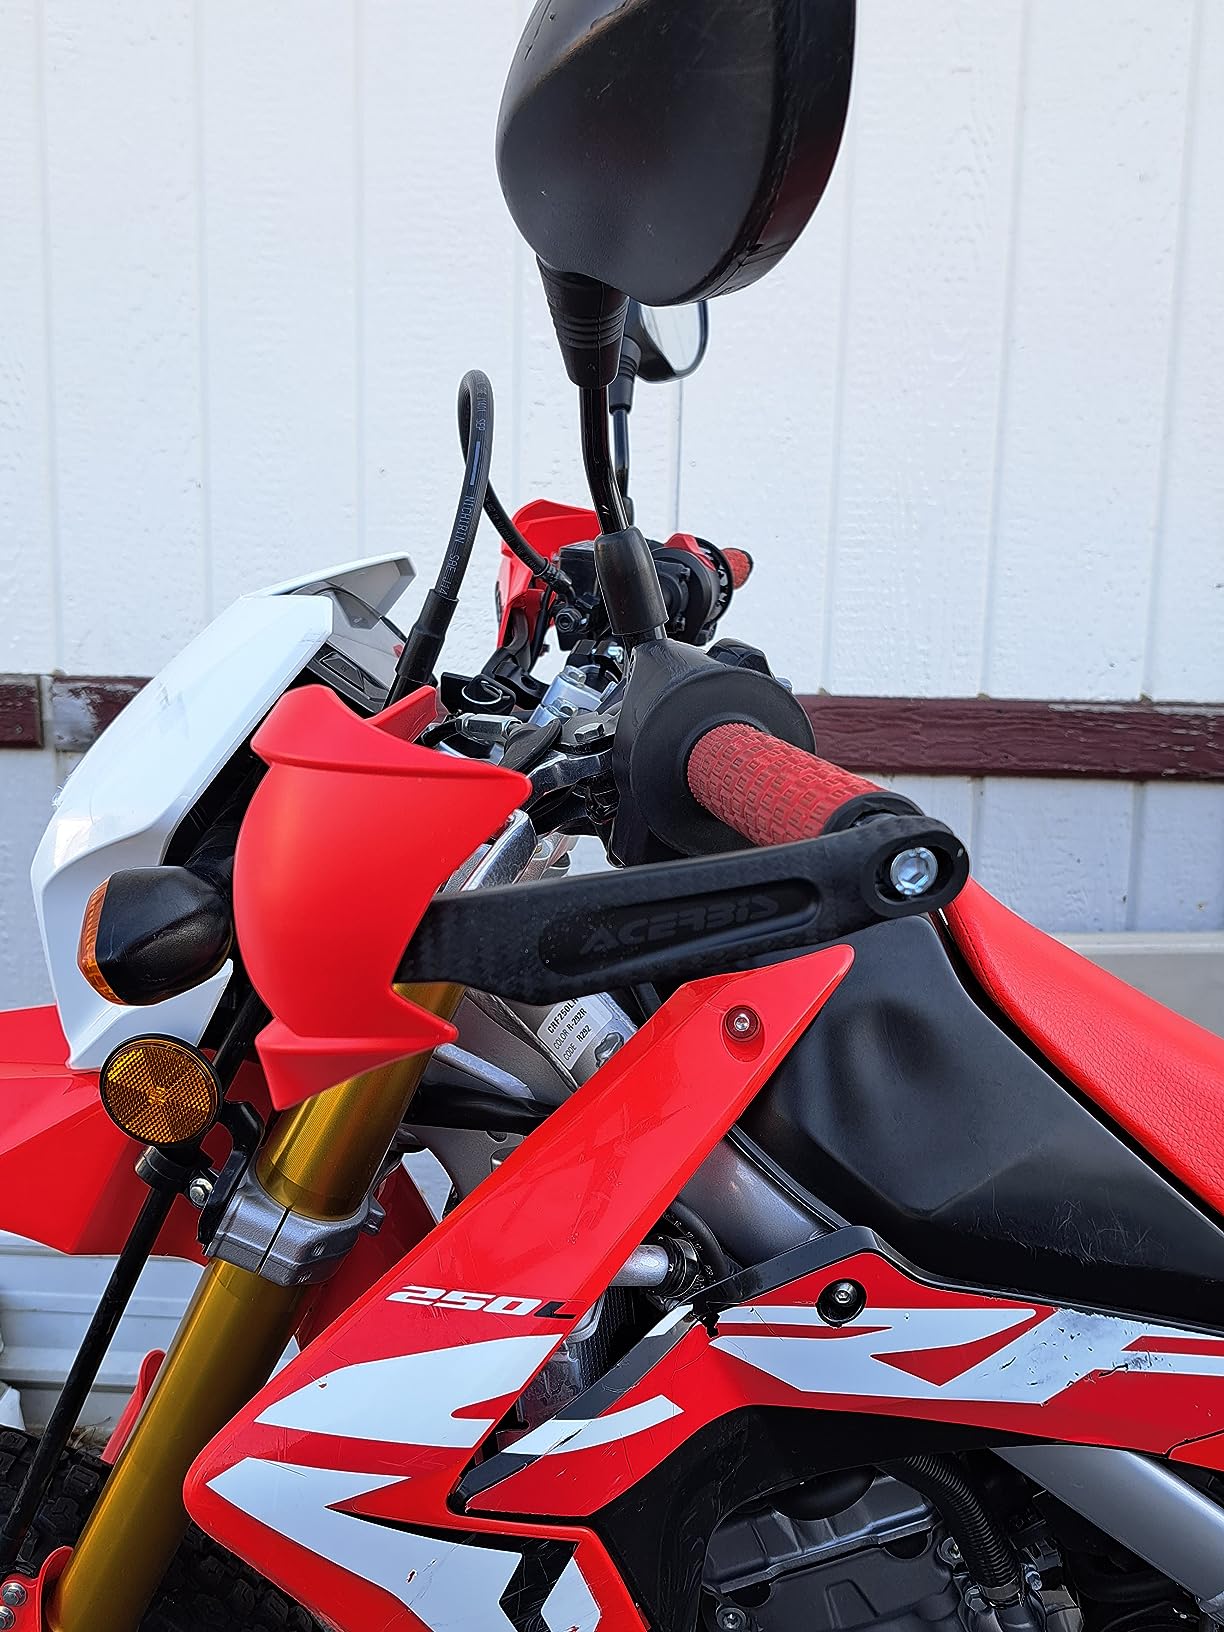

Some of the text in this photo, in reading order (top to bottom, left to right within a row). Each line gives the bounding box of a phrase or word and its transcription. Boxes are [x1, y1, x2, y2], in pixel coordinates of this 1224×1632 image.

[454, 495, 475, 544] NICHIRIN
[554, 1029, 570, 1050] COLOR
[563, 1043, 577, 1060] CODE
[385, 1285, 576, 1320] 250L
